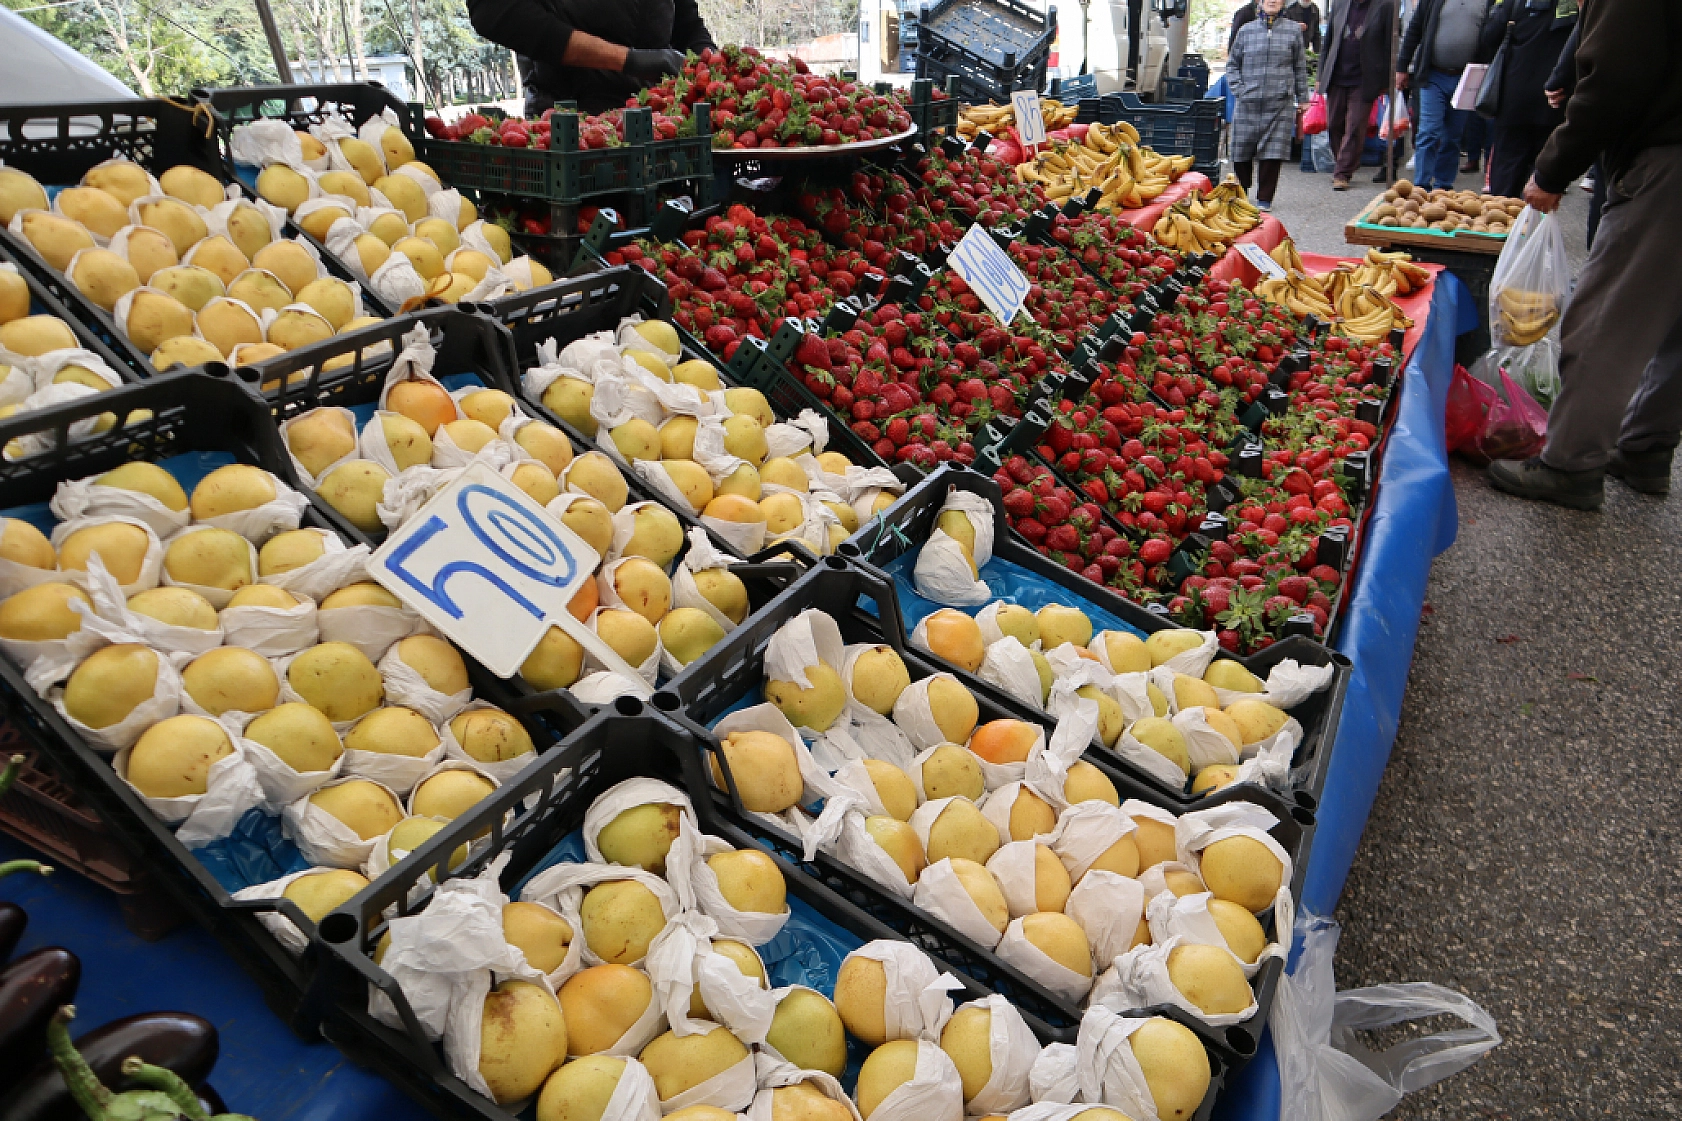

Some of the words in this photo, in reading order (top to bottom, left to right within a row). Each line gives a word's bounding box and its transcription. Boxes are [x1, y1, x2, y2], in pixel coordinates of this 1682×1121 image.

[1016, 96, 1045, 141] 85
[955, 229, 1026, 322] 100
[384, 484, 577, 621] 50
